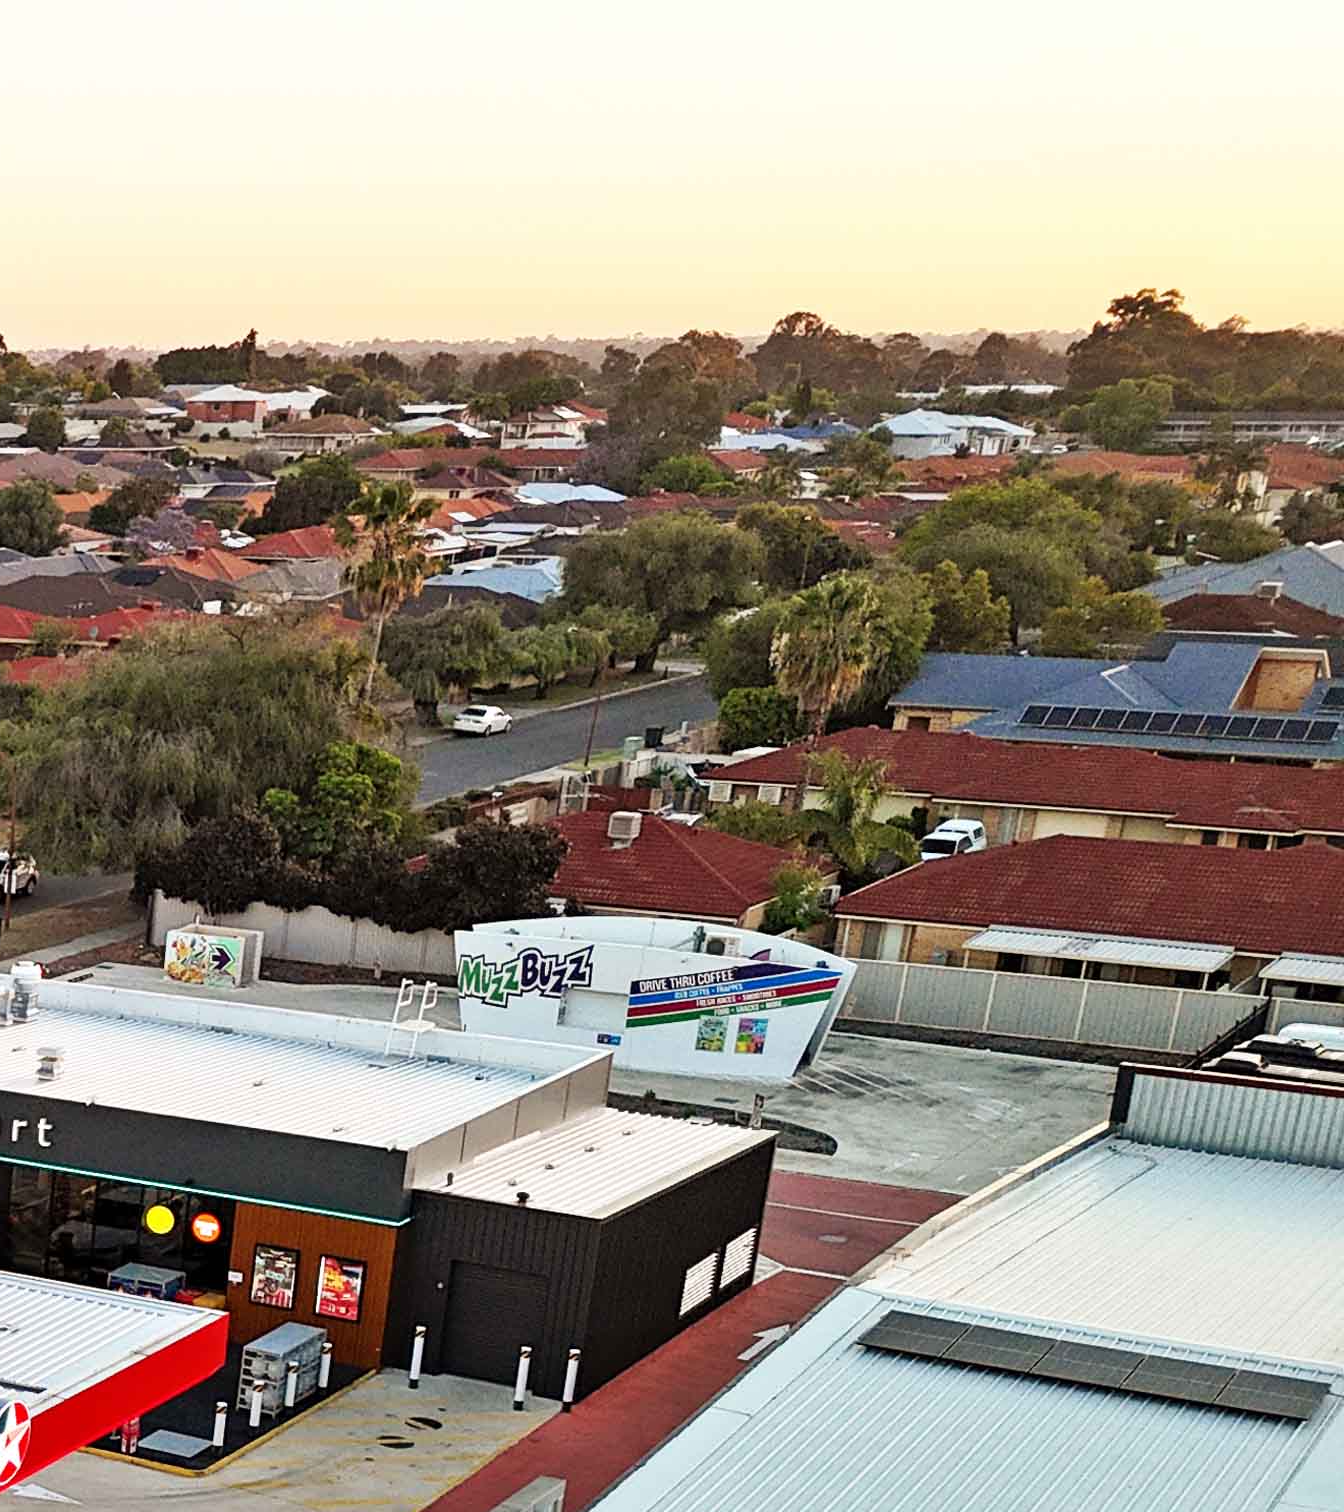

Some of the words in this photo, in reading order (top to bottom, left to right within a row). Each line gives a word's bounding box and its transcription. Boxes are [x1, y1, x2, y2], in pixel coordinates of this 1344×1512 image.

[639, 979, 669, 993] DRIVE
[670, 976, 696, 988] THRU
[697, 969, 735, 985] COFFEE
